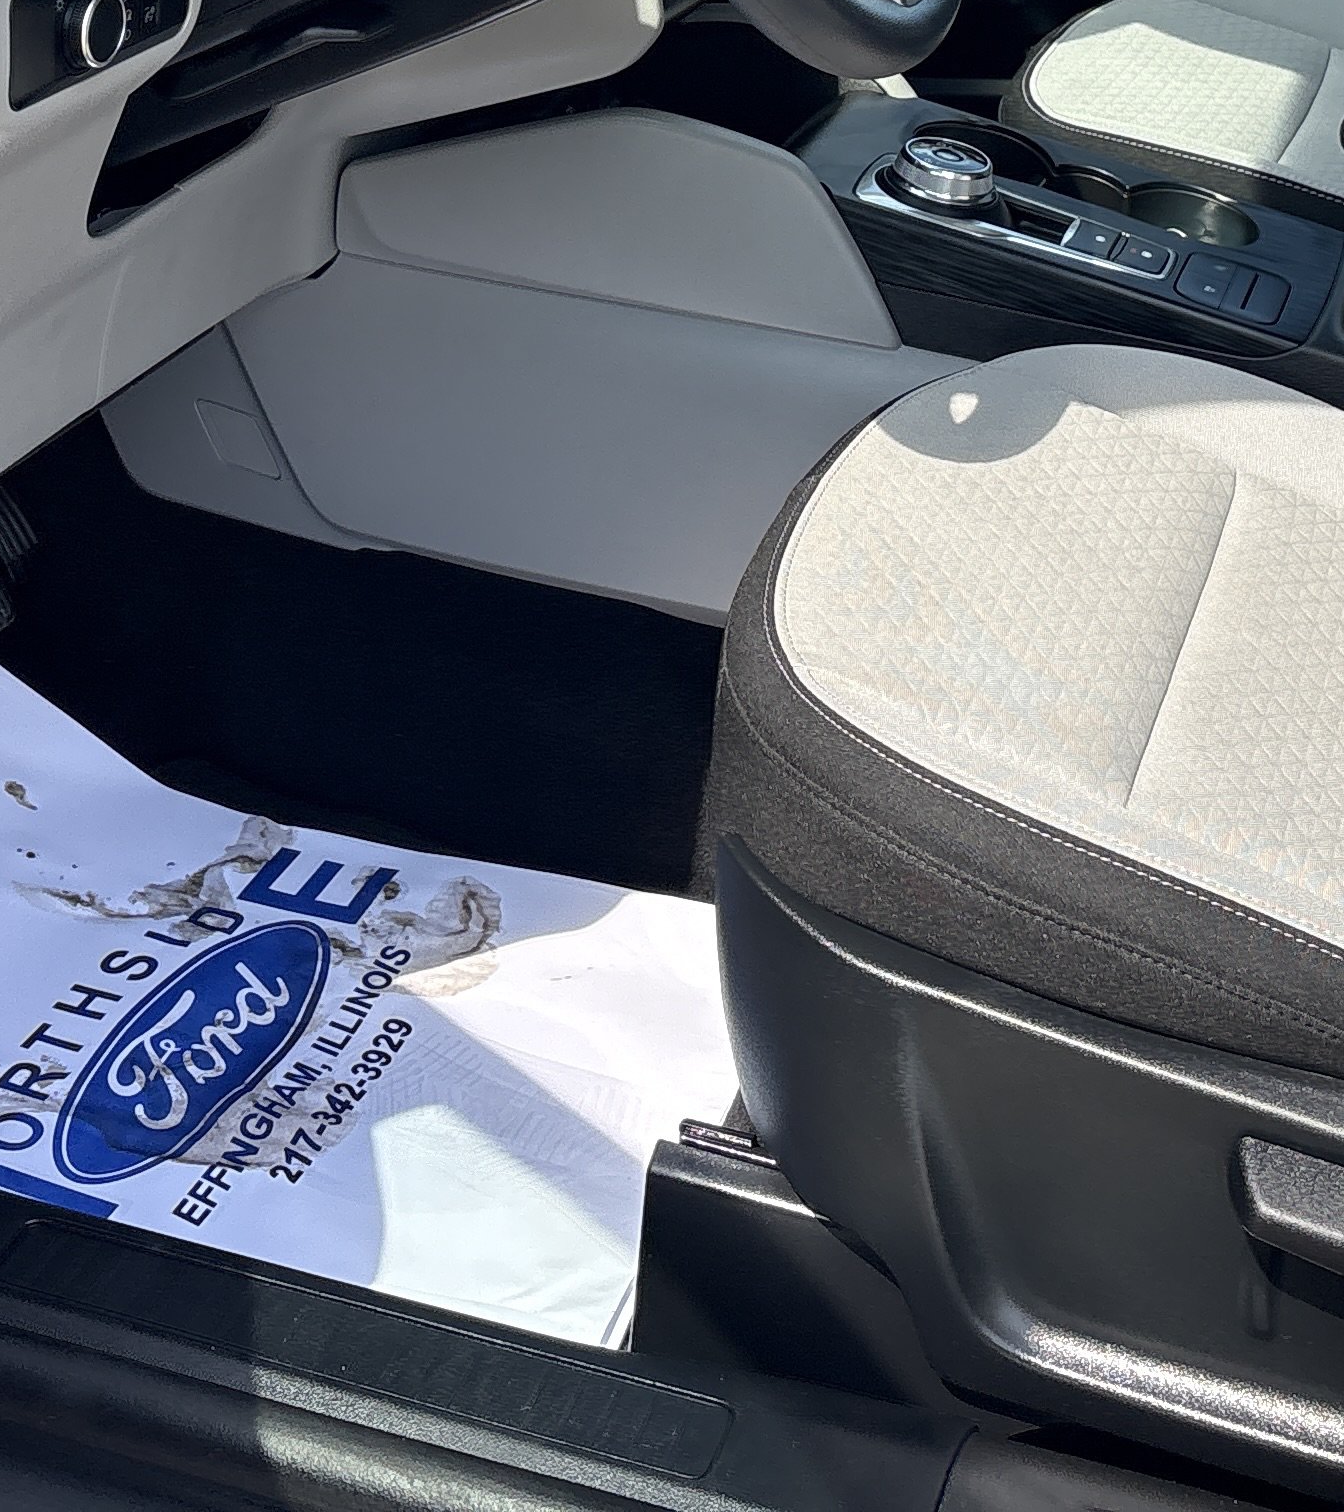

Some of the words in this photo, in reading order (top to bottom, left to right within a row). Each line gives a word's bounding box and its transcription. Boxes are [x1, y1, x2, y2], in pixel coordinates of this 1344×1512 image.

[107, 961, 292, 1130] Ford
[172, 1061, 332, 1227] EFFINGHAM,
[311, 944, 413, 1057] ILLINOIS
[269, 1017, 414, 1184] 217-342-3929
